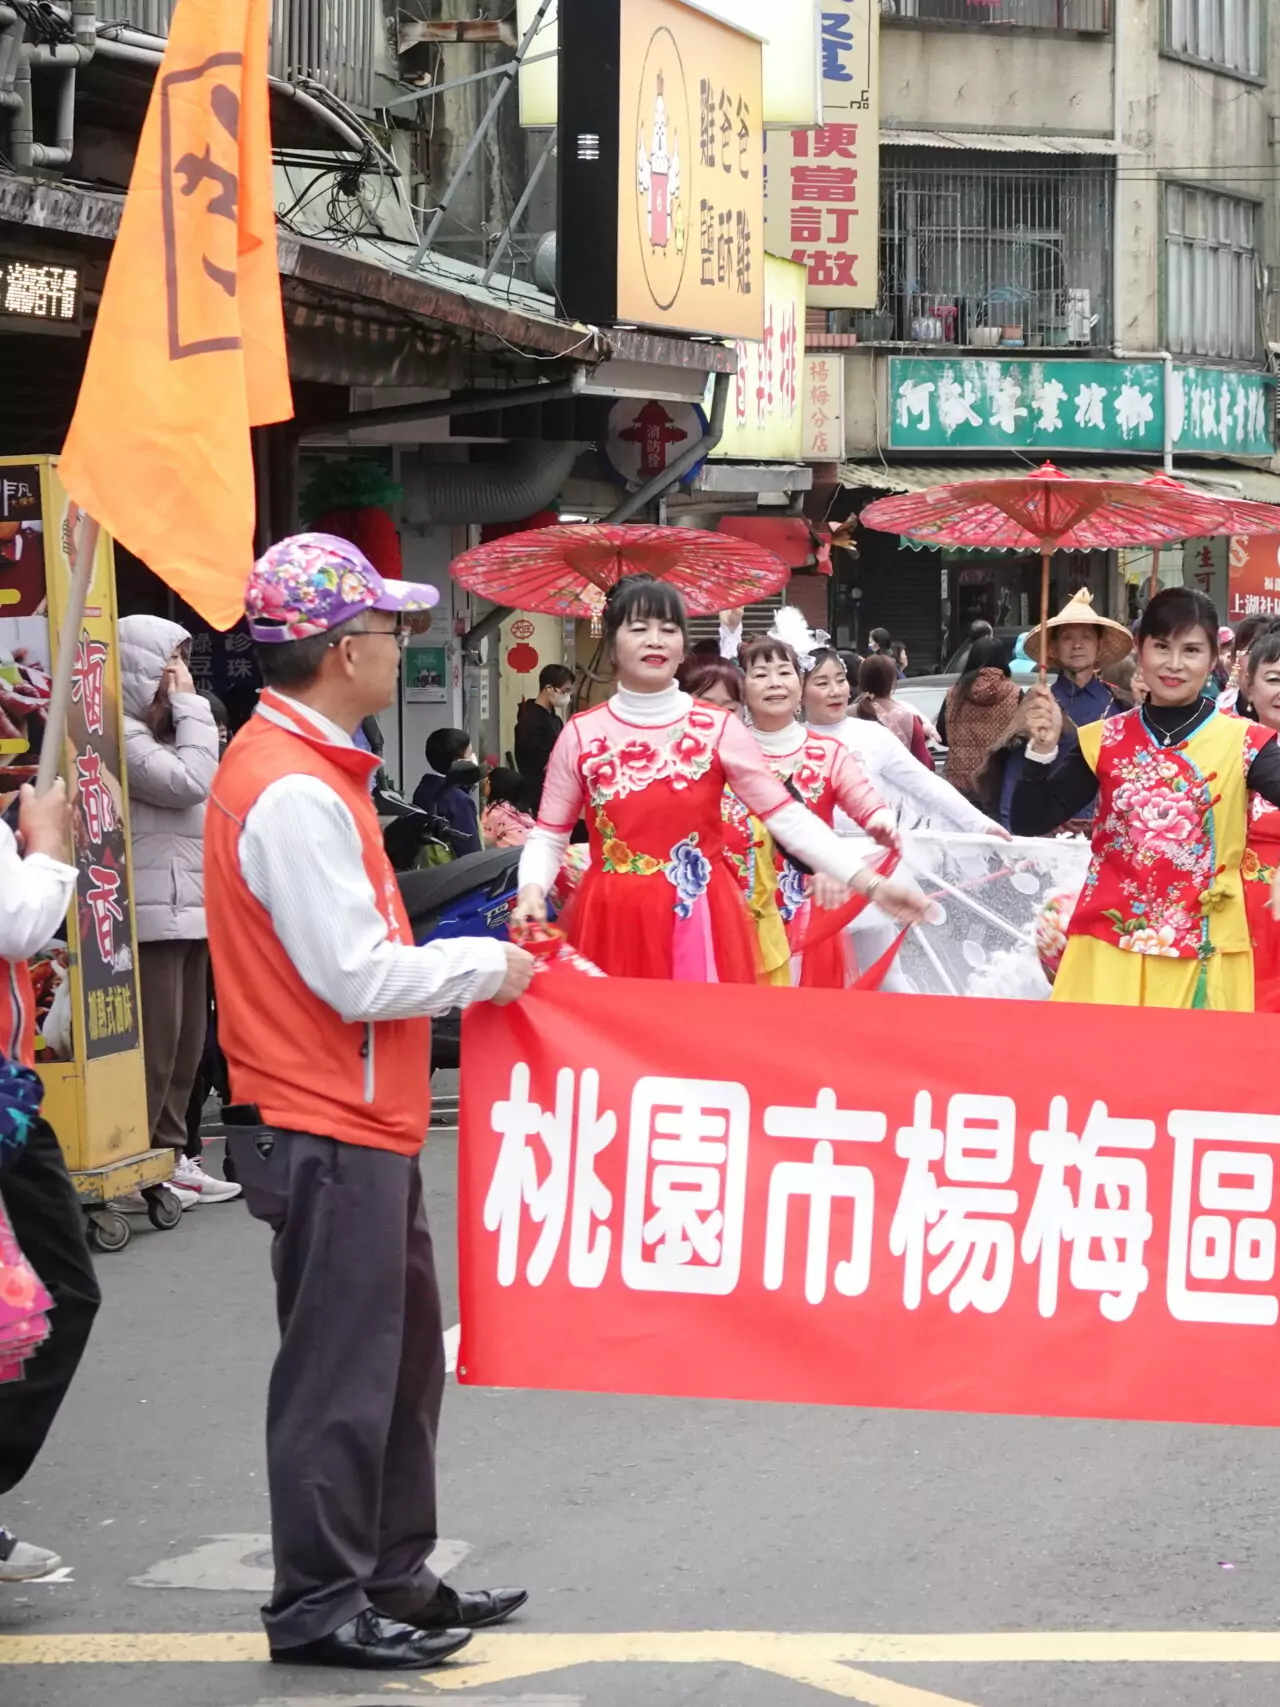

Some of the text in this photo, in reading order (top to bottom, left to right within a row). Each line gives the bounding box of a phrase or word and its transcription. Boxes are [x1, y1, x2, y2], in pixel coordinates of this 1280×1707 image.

[700, 78, 750, 180] 雞爸爸
[700, 199, 752, 295] 鹽酥雞
[790, 122, 859, 287] 便當訂做
[809, 360, 830, 453] 楊梅分店
